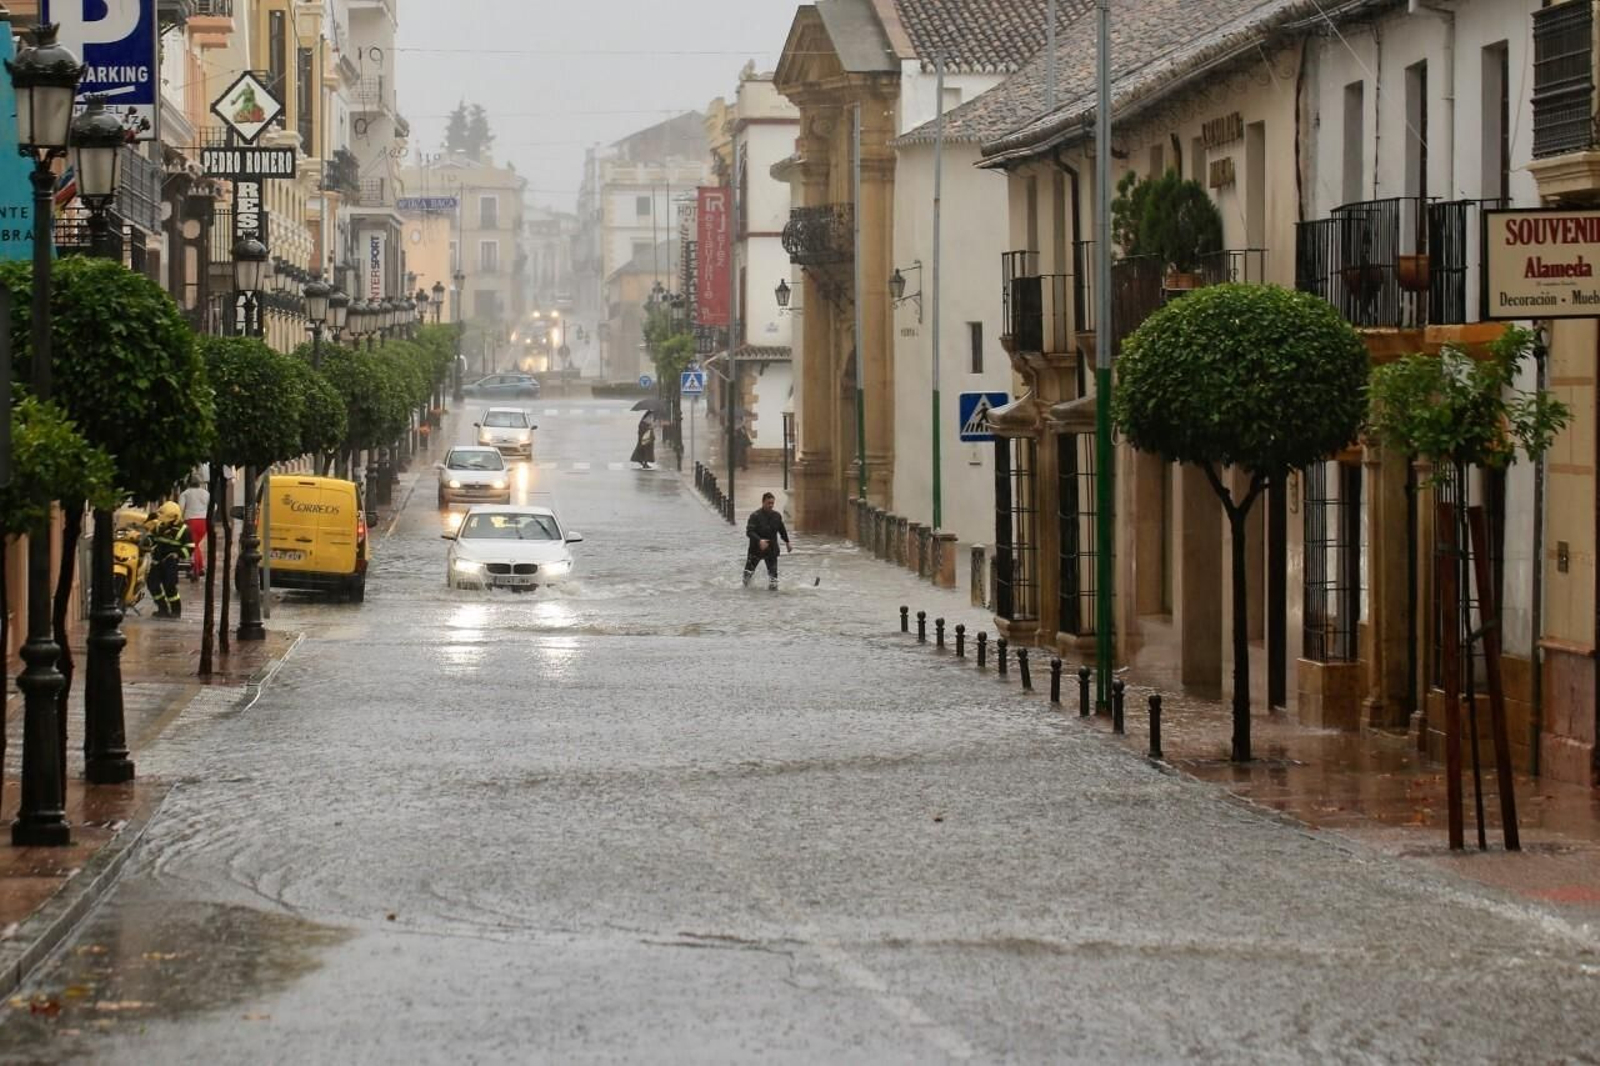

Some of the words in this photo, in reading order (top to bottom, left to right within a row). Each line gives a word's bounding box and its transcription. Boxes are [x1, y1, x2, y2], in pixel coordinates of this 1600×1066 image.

[80, 66, 148, 83] ARKING
[204, 151, 241, 173] PEDRO
[246, 151, 292, 173] ROMERO
[1524, 255, 1593, 279] Alameda
[1500, 291, 1557, 307] Decoración
